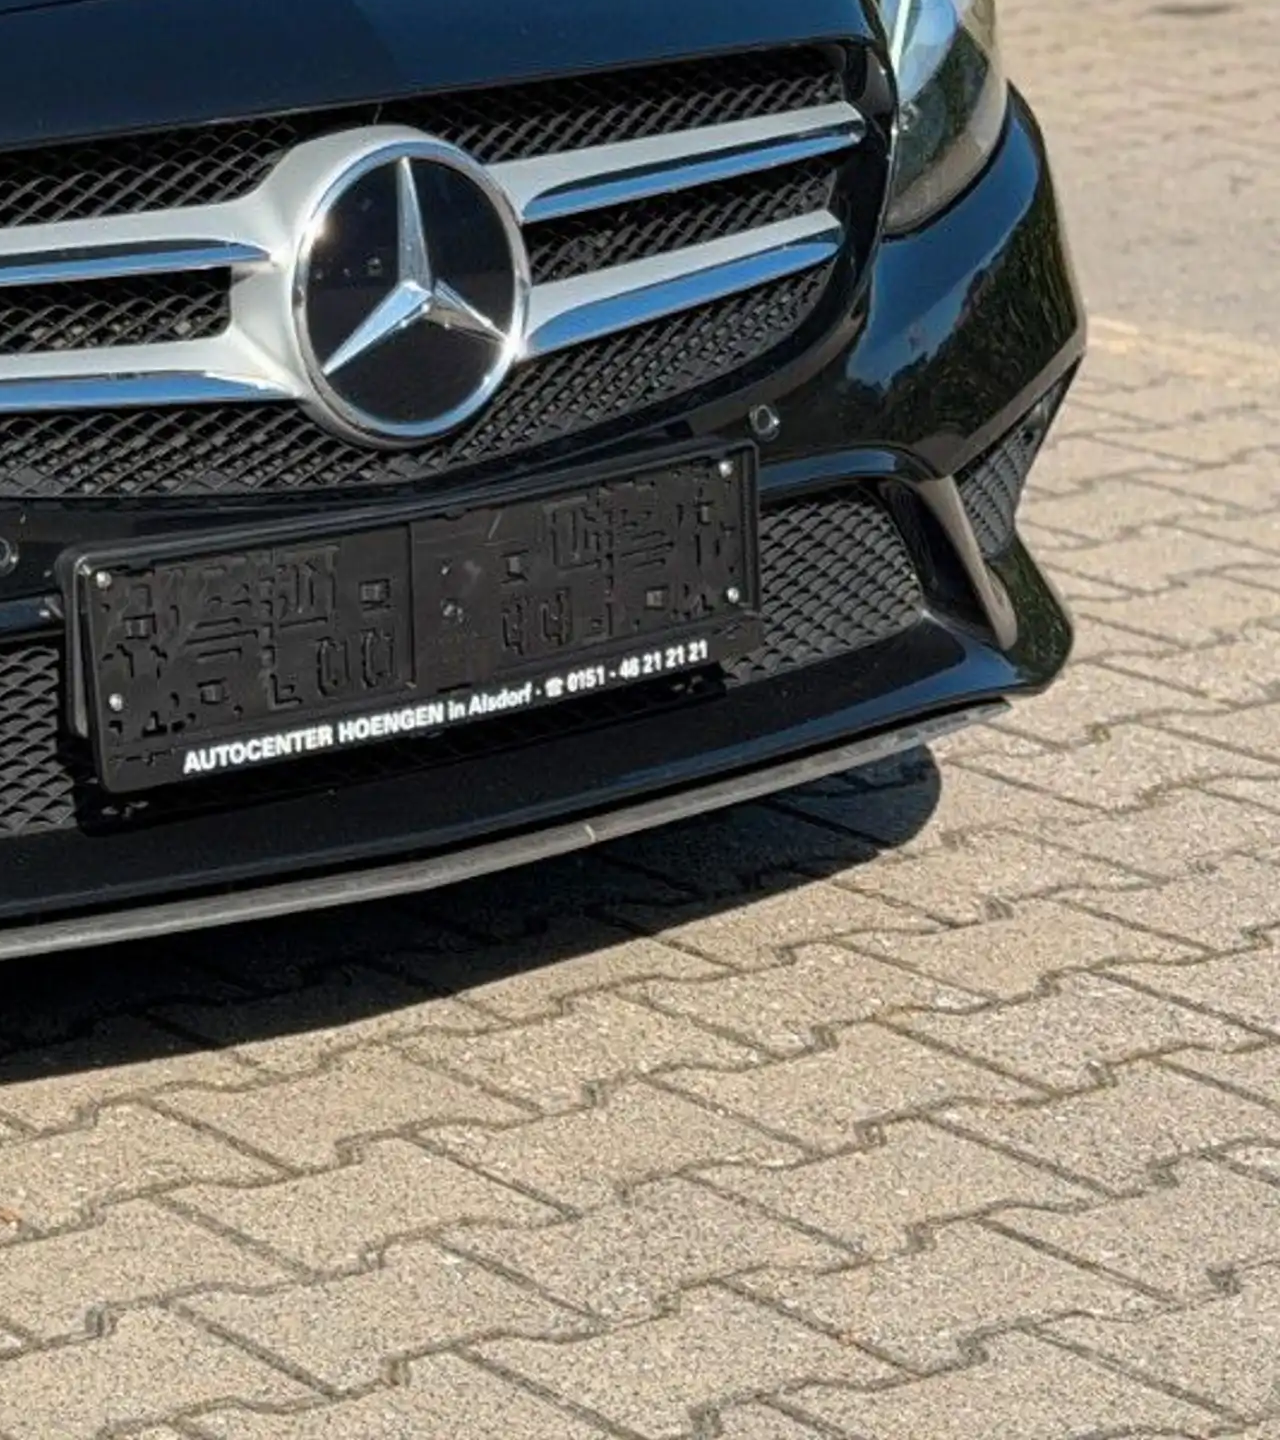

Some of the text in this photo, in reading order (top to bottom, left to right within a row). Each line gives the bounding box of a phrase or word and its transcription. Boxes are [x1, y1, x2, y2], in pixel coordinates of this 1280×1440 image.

[182, 725, 334, 775] AUTOCENTER
[338, 702, 444, 744] HOENGEN
[447, 700, 467, 720] in
[469, 680, 534, 717] Alsdorf
[566, 665, 606, 693] 0151
[642, 651, 663, 674] 21
[665, 644, 686, 669] 21
[687, 638, 709, 663] 21
